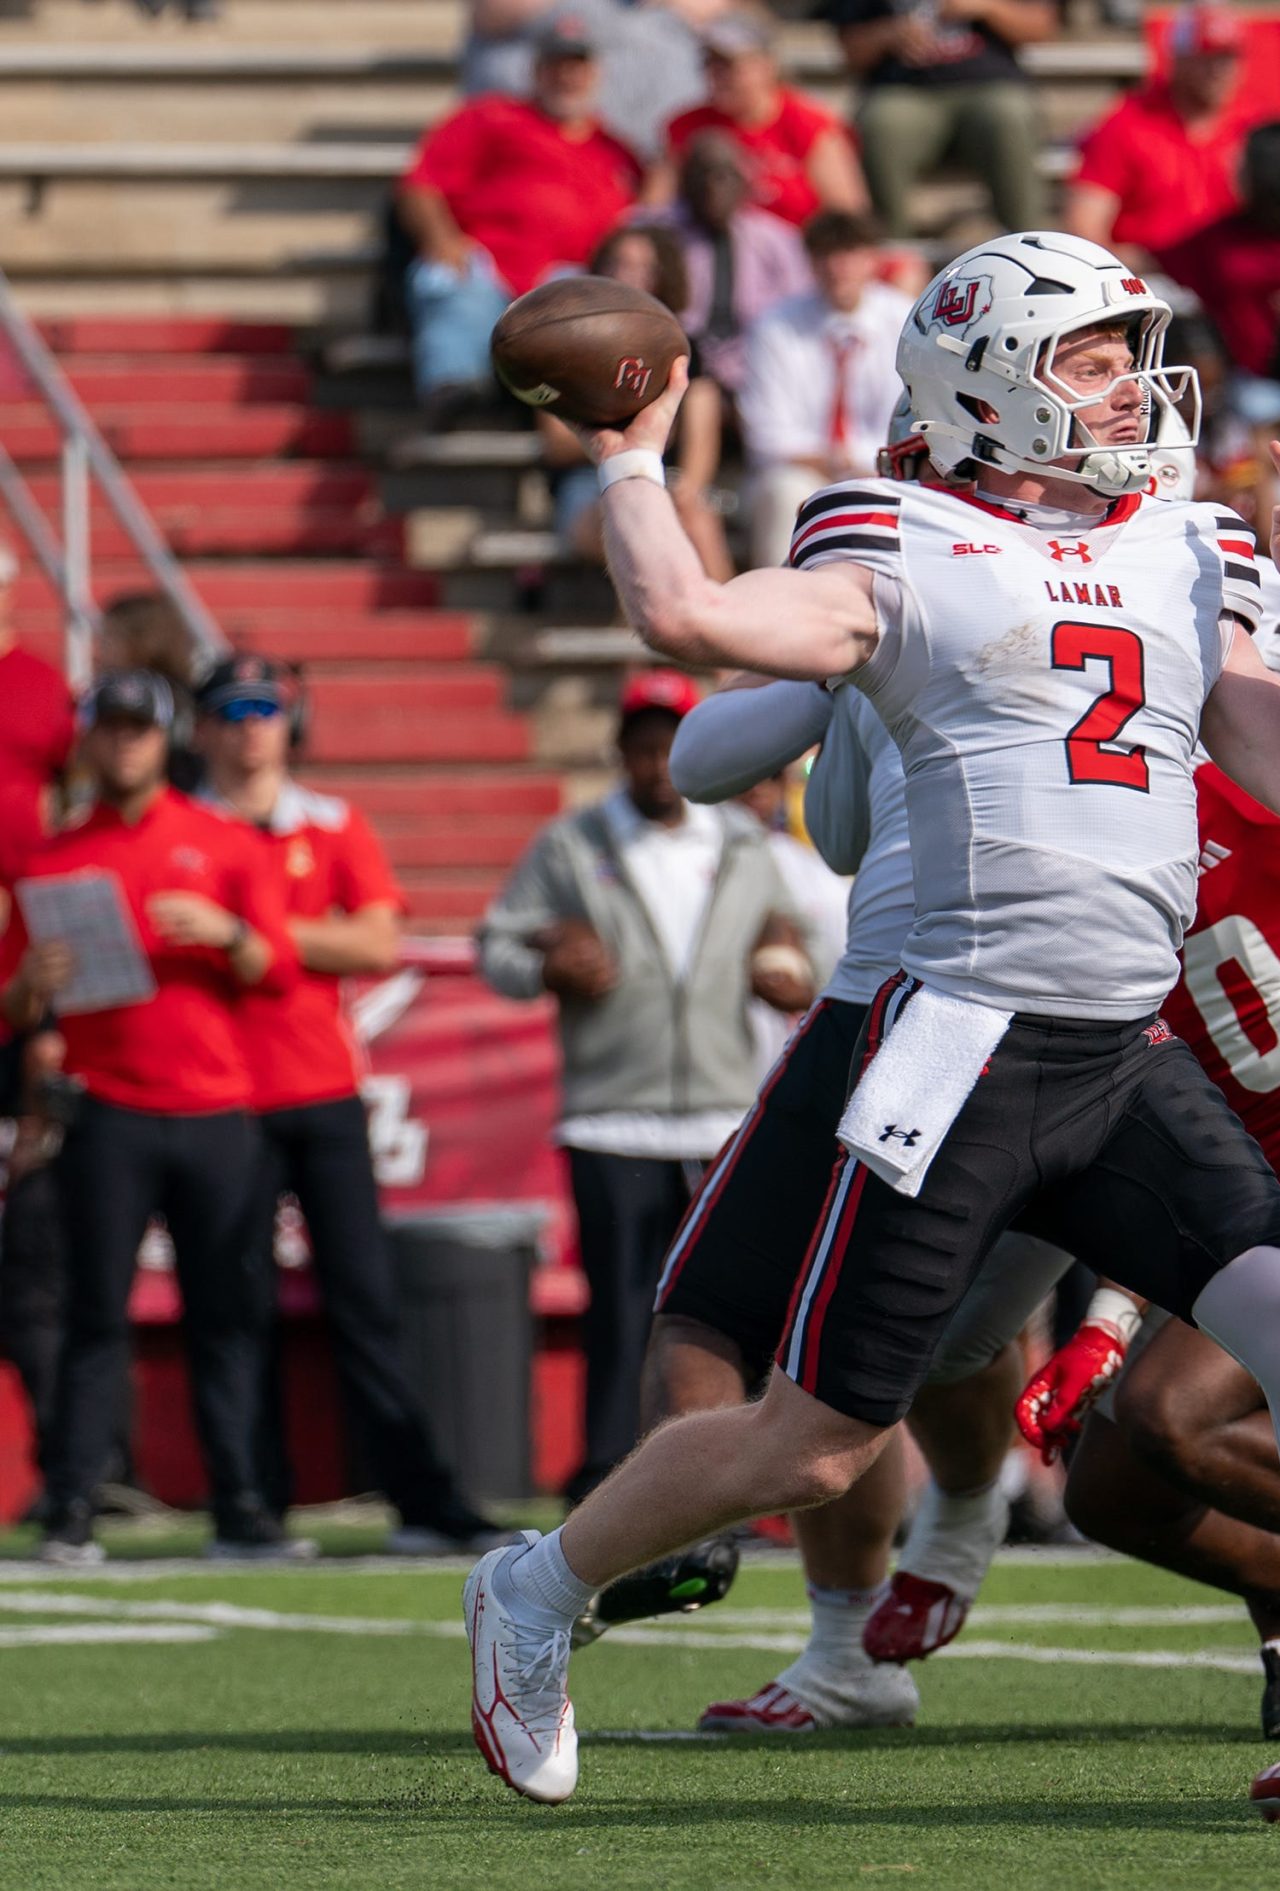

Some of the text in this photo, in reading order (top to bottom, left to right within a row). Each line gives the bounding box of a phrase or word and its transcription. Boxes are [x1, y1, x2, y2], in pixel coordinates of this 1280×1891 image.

[931, 280, 980, 327] LU
[1044, 580, 1123, 608] LAMAR
[1050, 620, 1150, 794] 2
